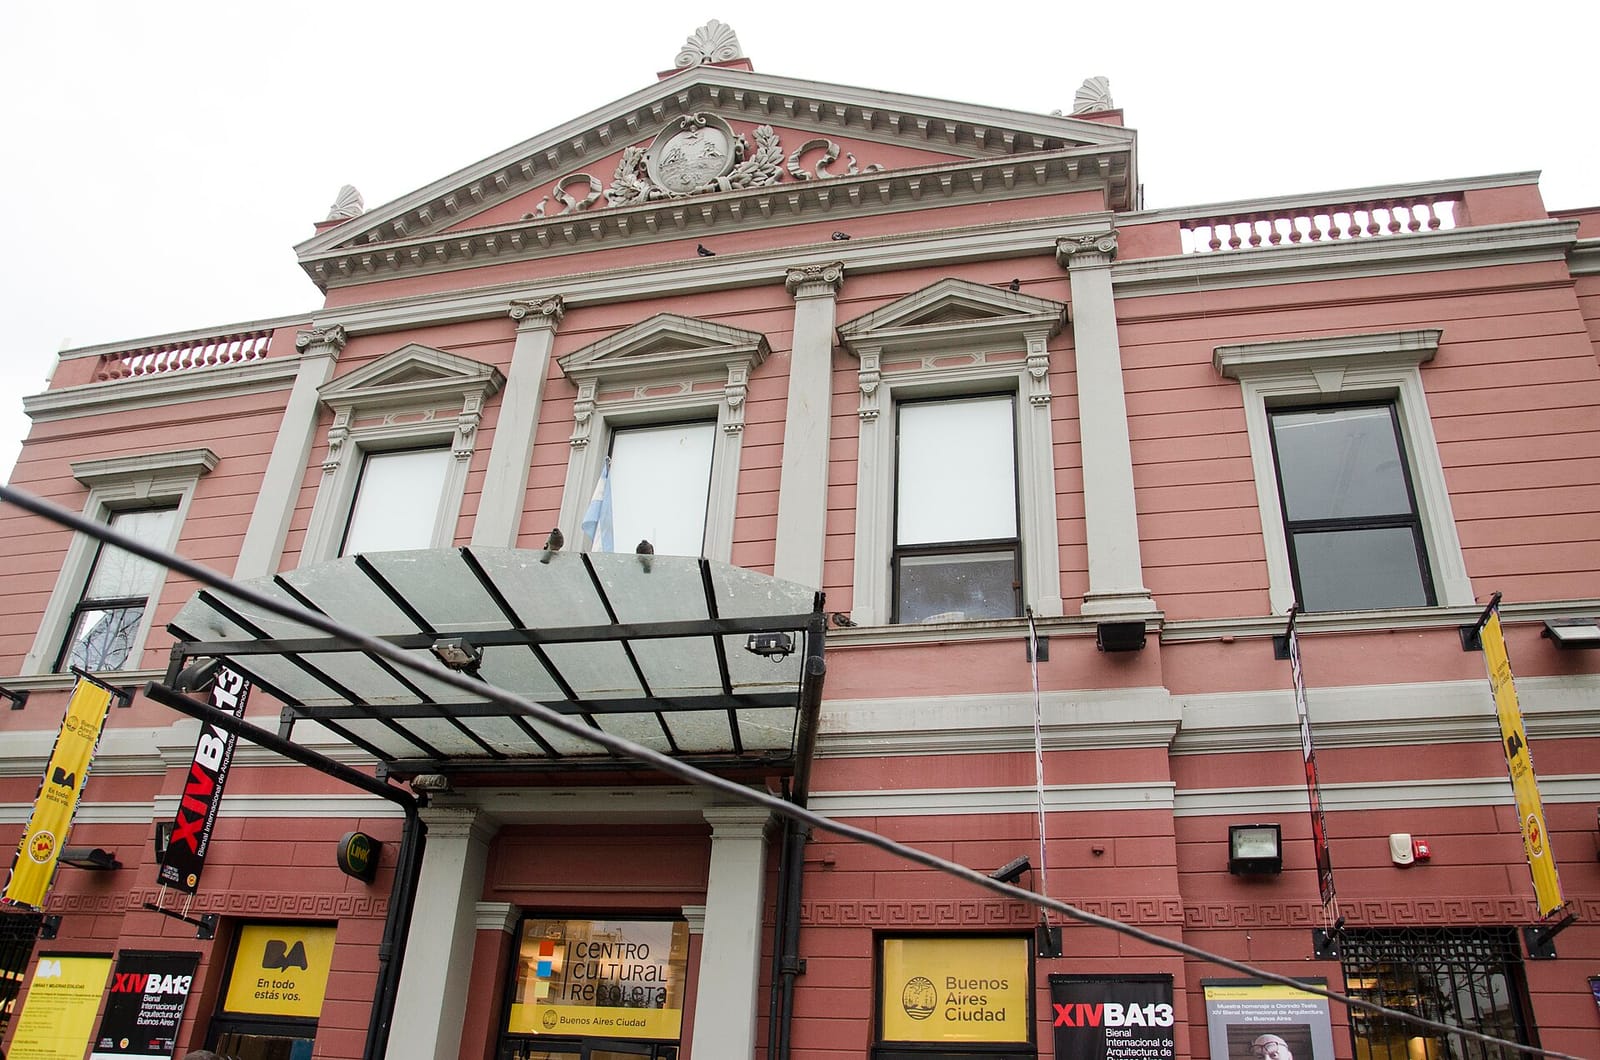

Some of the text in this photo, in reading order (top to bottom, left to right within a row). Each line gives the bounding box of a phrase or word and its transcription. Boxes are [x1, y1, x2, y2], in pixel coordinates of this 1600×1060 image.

[52, 766, 75, 790] BA
[199, 784, 221, 833] Internacional
[213, 773, 225, 785] de
[221, 733, 235, 773] Arquitectur
[262, 939, 308, 973] BA
[37, 959, 62, 979] BA
[111, 973, 193, 995] XIVBA13
[257, 979, 295, 990] En todo
[946, 976, 1009, 991] Buenos
[143, 994, 161, 1003] Bienal
[254, 990, 301, 1002] estás vos.
[945, 991, 988, 1007] Aires
[141, 1002, 177, 1011] Internacional
[1241, 1003, 1270, 1011] homenaje
[138, 1010, 173, 1019] Arquitectura
[944, 1007, 1007, 1023] Ciudad
[1053, 1003, 1175, 1028] XIVBA13
[136, 1018, 175, 1027] Buenos Aires
[559, 1016, 647, 1028] Buenos Aires Ciudad
[1105, 1028, 1132, 1038] Bienal
[1106, 1038, 1174, 1048] Internacional de
[1106, 1048, 1172, 1058] Arquitectura de
